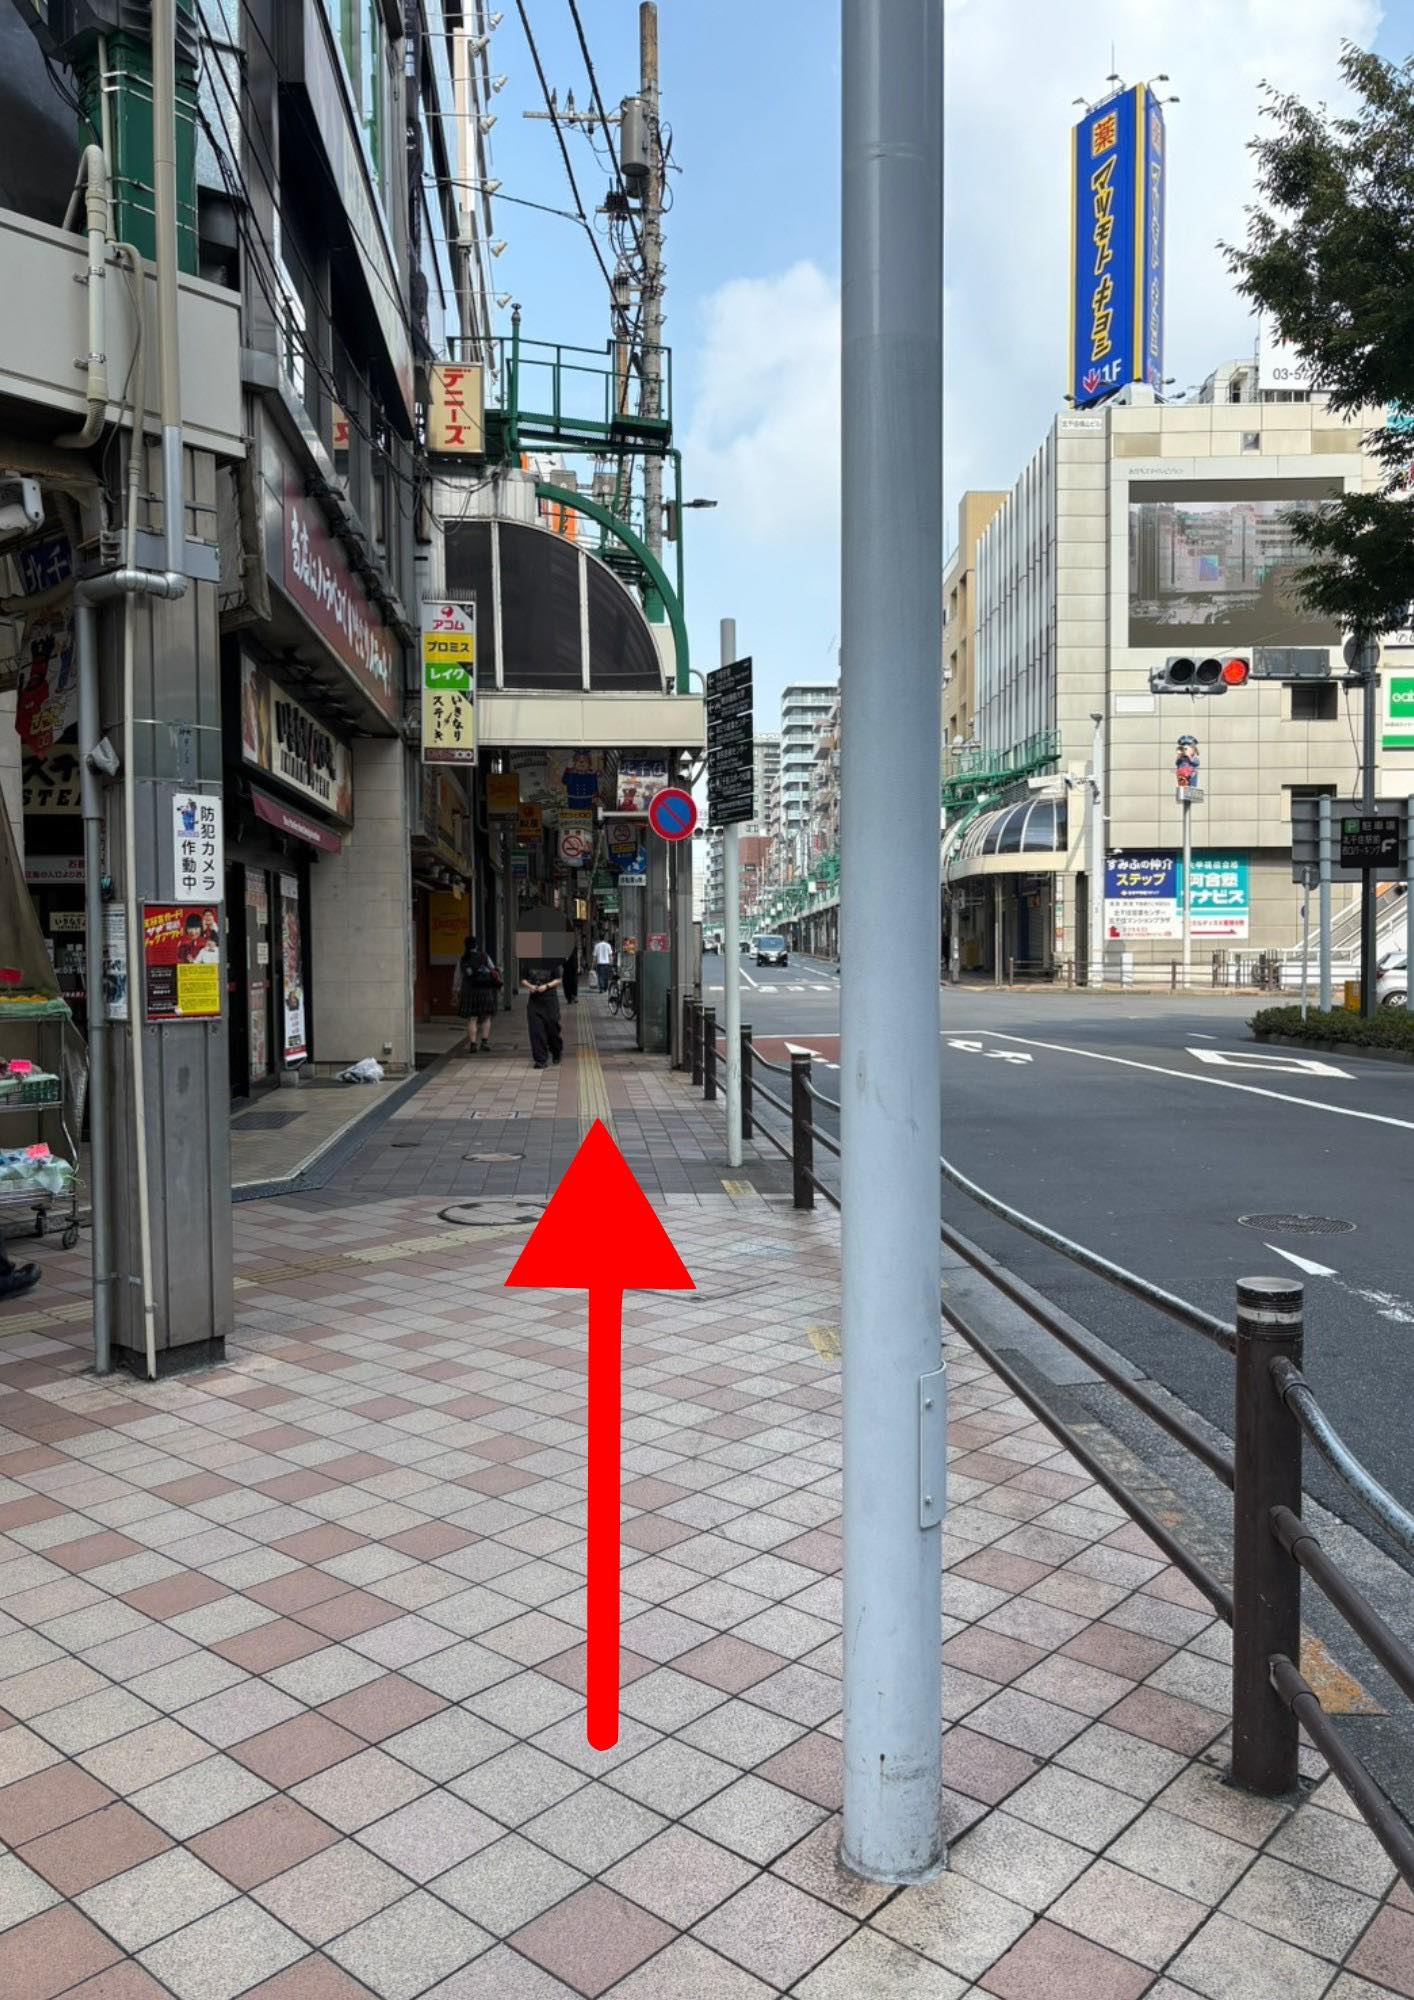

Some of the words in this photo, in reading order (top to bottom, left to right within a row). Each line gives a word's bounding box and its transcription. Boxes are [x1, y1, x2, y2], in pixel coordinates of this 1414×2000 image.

[1093, 115, 1116, 153] 薬
[1091, 154, 1117, 362] マツモトキヨシ
[1100, 358, 1122, 384] 1F
[443, 367, 472, 447] デニーズ
[432, 619, 465, 630] アコム
[427, 641, 470, 652] プロミス
[430, 667, 465, 681] レイク
[433, 695, 444, 743] ステーキ
[451, 695, 463, 742] いきなり
[22, 754, 81, 786] ステ
[1361, 820, 1395, 831] 駐車場
[200, 806, 216, 890] 防犯カメラ
[182, 840, 197, 891] 作動中
[1106, 858, 1173, 871] すみふの仲介
[1116, 872, 1167, 887] ステップ
